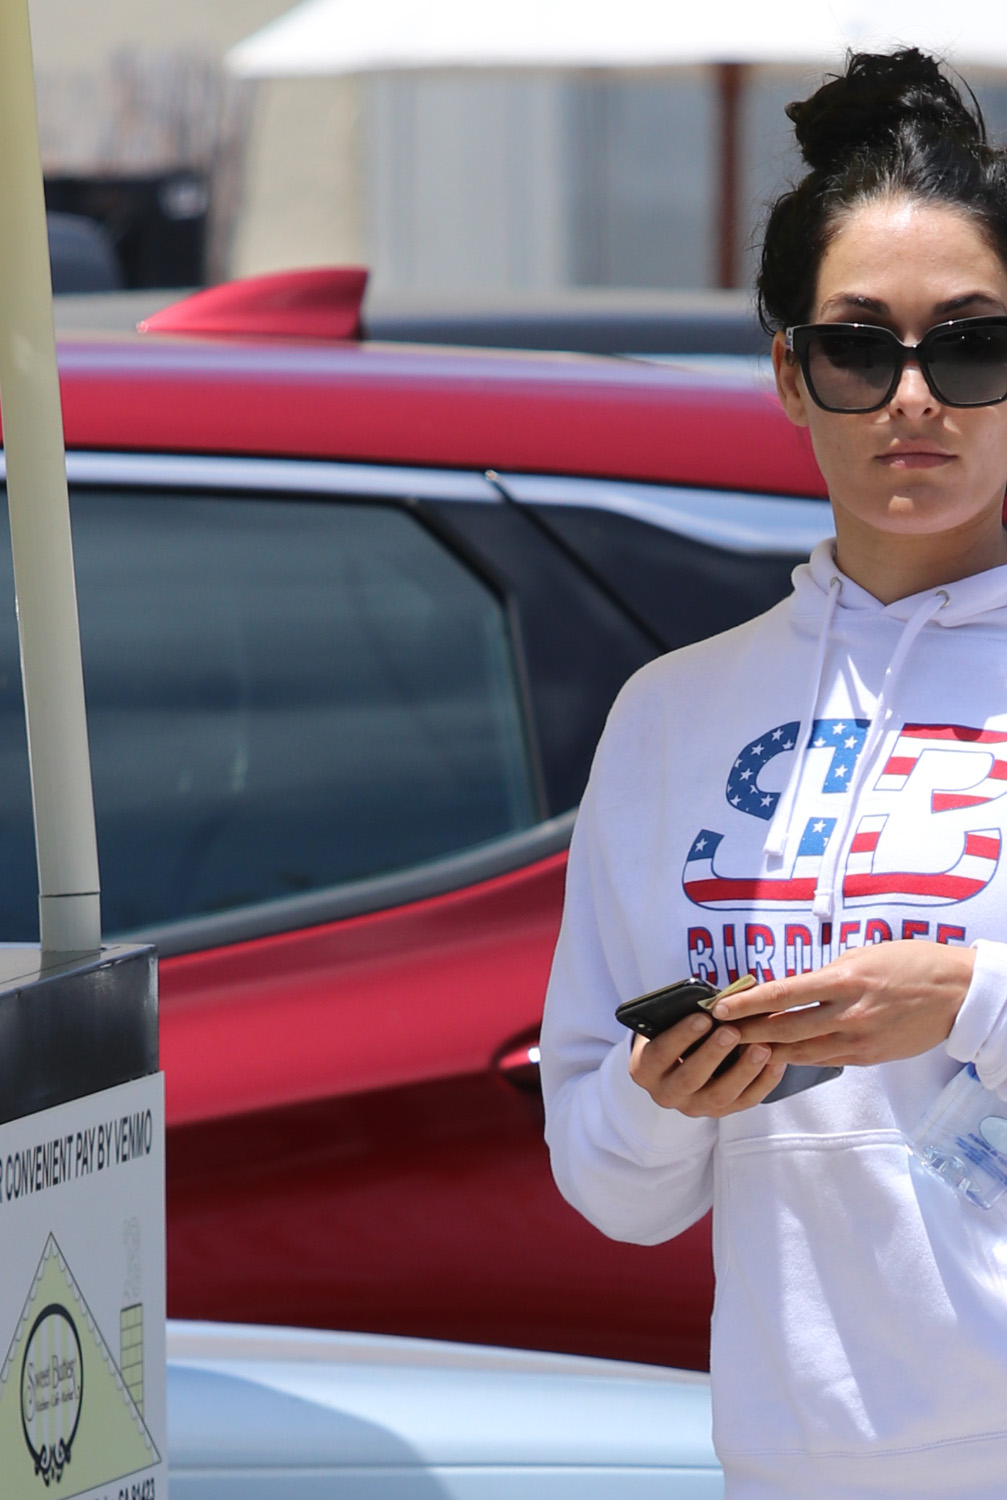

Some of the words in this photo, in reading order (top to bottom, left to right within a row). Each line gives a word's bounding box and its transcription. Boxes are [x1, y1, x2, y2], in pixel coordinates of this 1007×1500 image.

[5, 1133, 74, 1202] CONVENIENT
[75, 1126, 96, 1178] PAY
[97, 1121, 113, 1171] BY
[114, 1108, 153, 1165] VENMO
